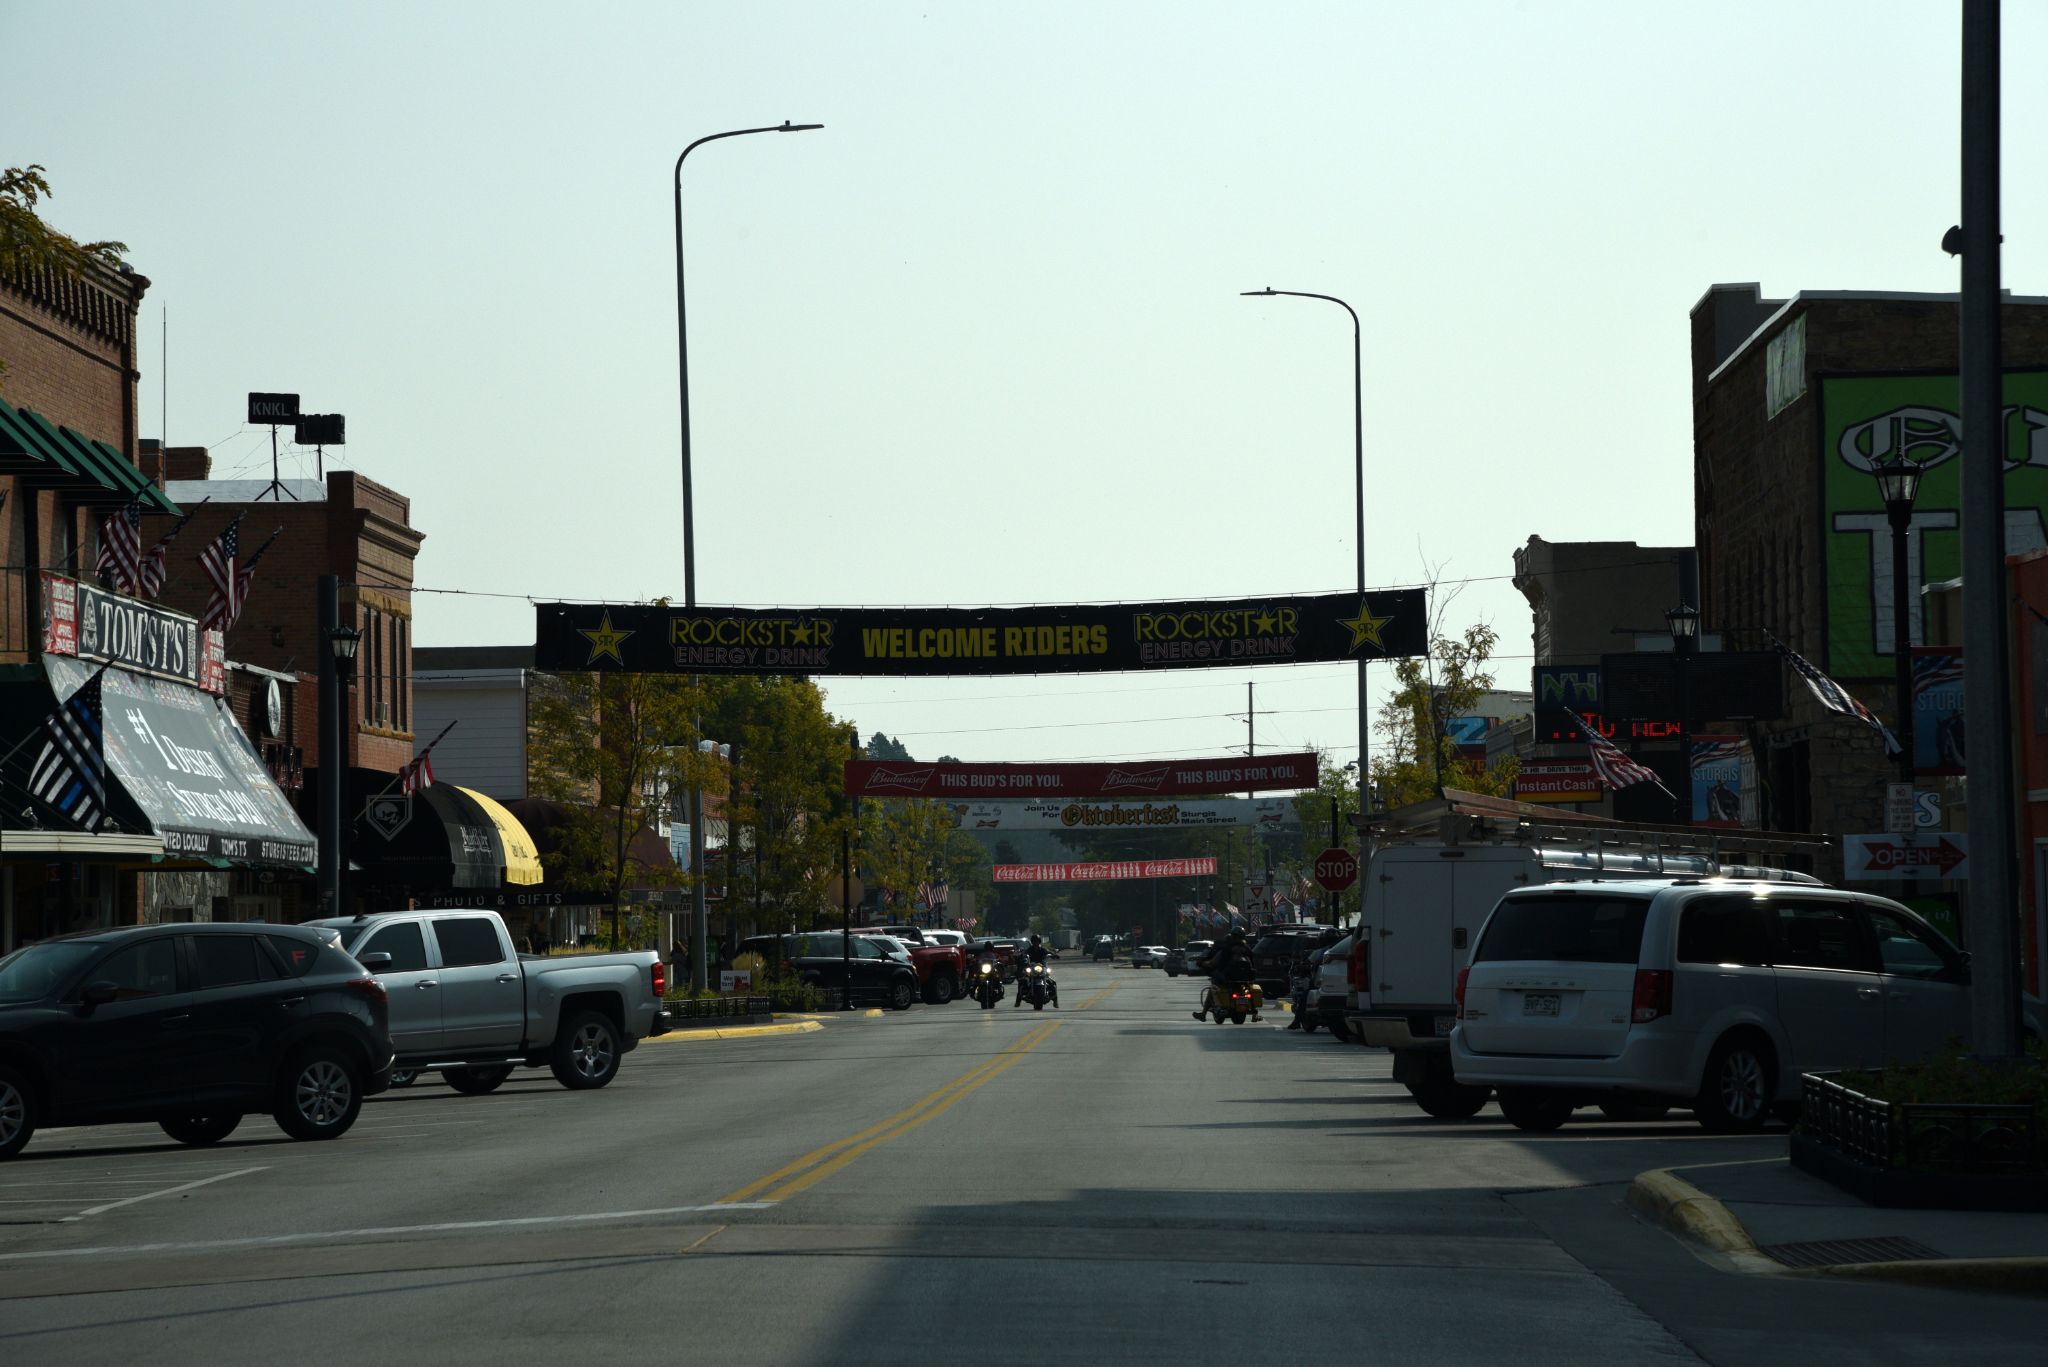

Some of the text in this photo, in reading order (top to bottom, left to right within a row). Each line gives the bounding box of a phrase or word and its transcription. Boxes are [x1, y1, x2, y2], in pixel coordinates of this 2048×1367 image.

[252, 401, 291, 417] KNKL
[100, 600, 158, 668] TOM'S
[161, 618, 184, 674] T'S
[861, 623, 1109, 659] WELCOME RIDERS
[1140, 635, 1297, 661] ENERGY DRINK
[676, 647, 830, 667] ENERGY DRINK
[126, 707, 179, 771] #1
[873, 771, 1064, 788] Budweiser THIS BUD'S FOR YOU.
[1108, 765, 1299, 787] Budweiser THIS BUD'S FOR YOU.
[1694, 766, 1738, 782] STURGIS
[1024, 804, 1060, 812] Join Us
[1061, 803, 1180, 827] Oktoberfest
[1181, 810, 1217, 818] Sturgis
[1181, 816, 1238, 825] Main Street
[182, 832, 210, 852] LOCALLY
[261, 840, 315, 863] STURGISTEES.COM
[1875, 848, 1931, 865] OPEN
[1317, 861, 1355, 878] STOP
[517, 893, 563, 905] GIFTS
